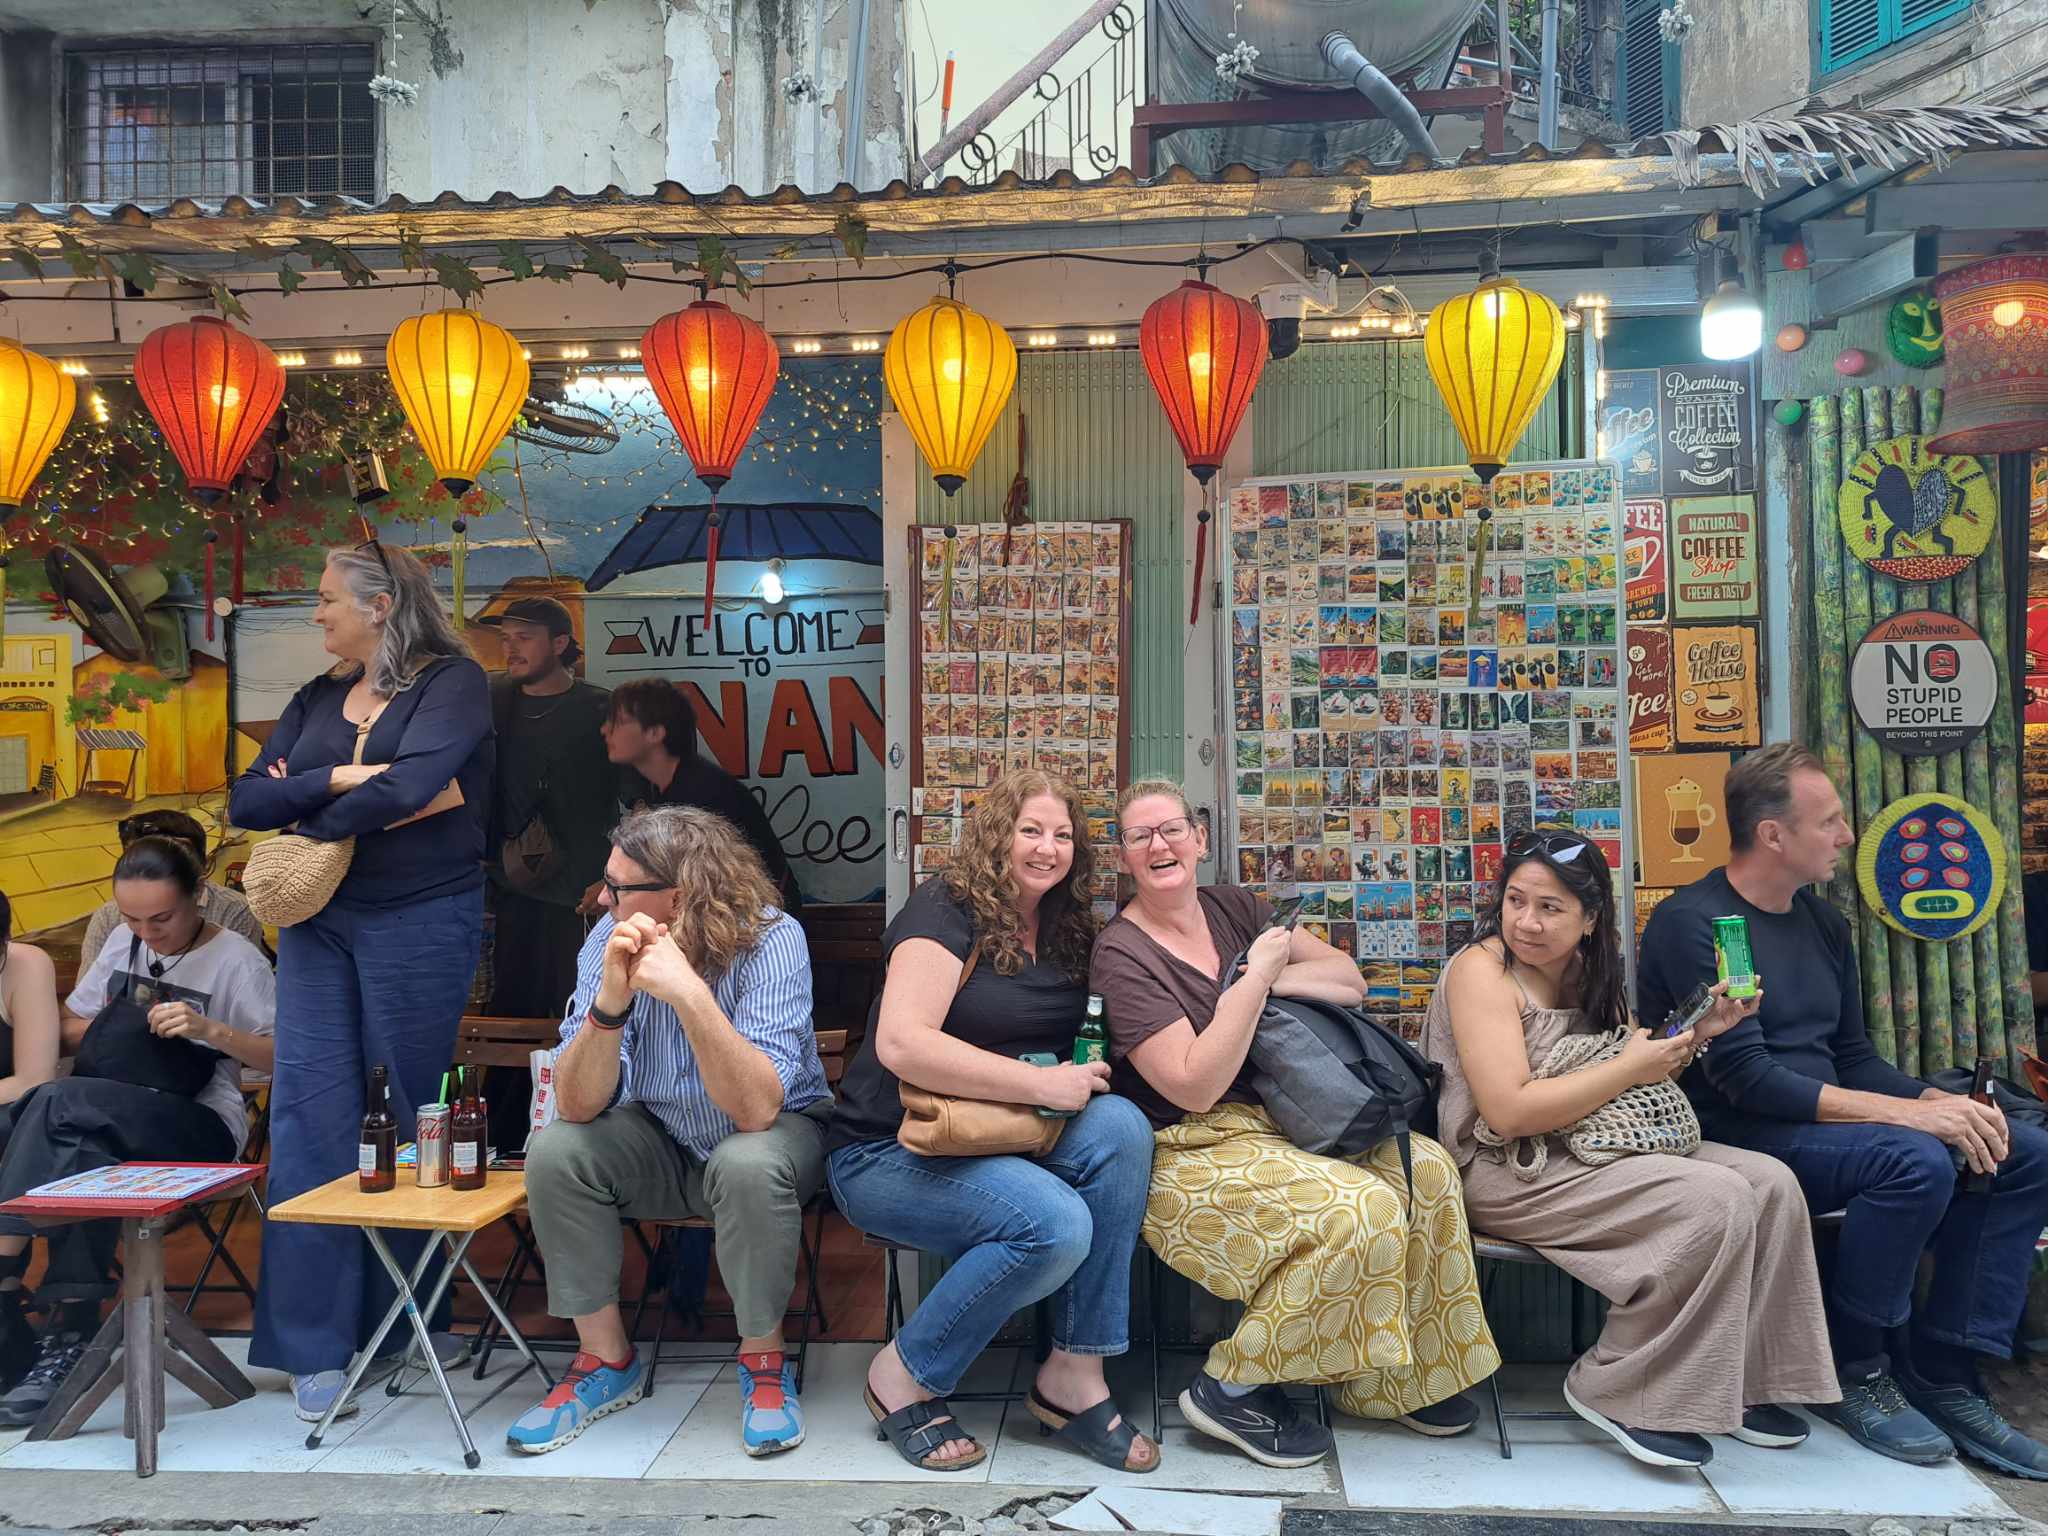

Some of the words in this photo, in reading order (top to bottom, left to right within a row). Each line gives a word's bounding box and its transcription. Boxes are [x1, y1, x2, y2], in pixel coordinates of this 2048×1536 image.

[1666, 372, 1745, 398] Premium
[1675, 404, 1737, 429] COFFEE
[1668, 427, 1741, 454] Collection
[1689, 516, 1740, 531] NATURAL
[1681, 536, 1745, 560] COFFEE
[1691, 556, 1735, 578] Shop
[1687, 586, 1713, 600] FRESH
[1714, 586, 1720, 599] &
[1722, 584, 1745, 599] TASTY
[643, 609, 855, 657] WELCOME
[1902, 624, 1960, 635] WARNING
[1688, 640, 1741, 663] Coffee
[739, 657, 770, 677] TO
[1635, 662, 1652, 678] Get
[1689, 661, 1746, 683] House
[1885, 643, 1960, 684] NO
[1887, 688, 1961, 705] STUPID
[1886, 707, 1963, 724] PEOPLE
